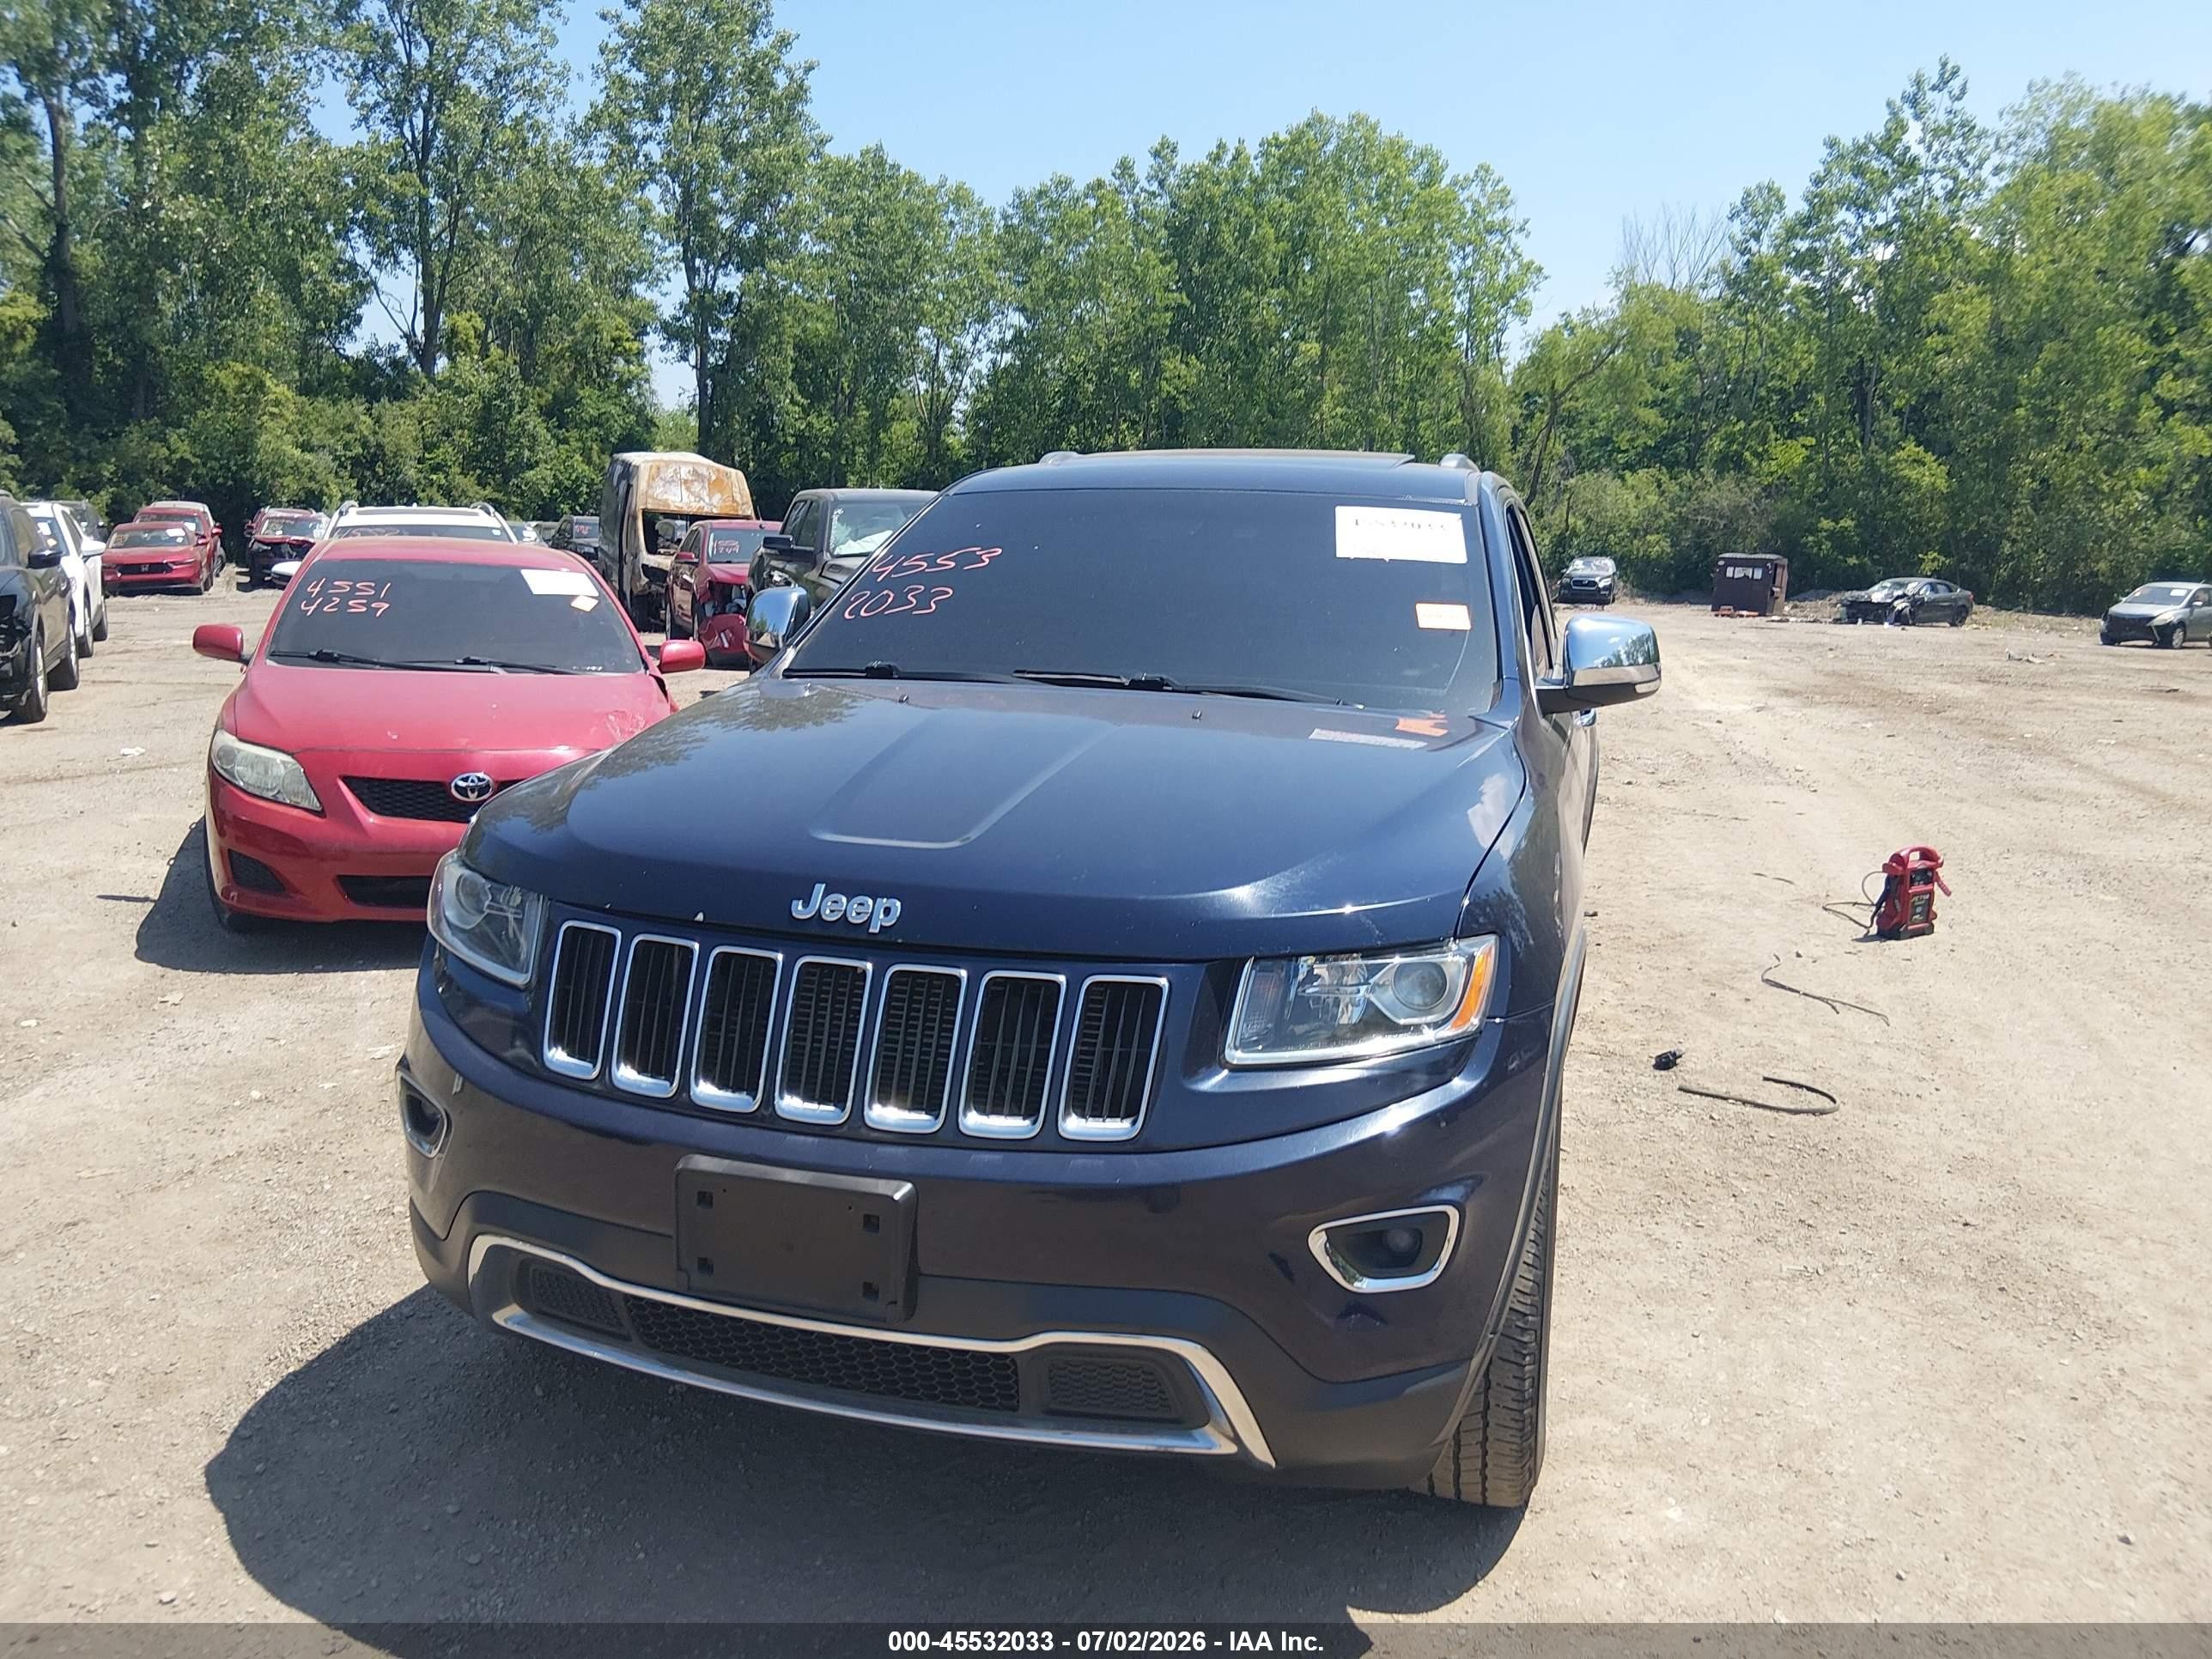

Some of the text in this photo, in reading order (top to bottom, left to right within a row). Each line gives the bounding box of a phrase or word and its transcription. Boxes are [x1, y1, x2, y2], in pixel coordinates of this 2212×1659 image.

[872, 547, 1003, 582] 4553
[307, 577, 392, 599] 4551
[844, 584, 954, 619] 2033
[301, 597, 391, 617] 4259
[791, 883, 902, 933] Jeep
